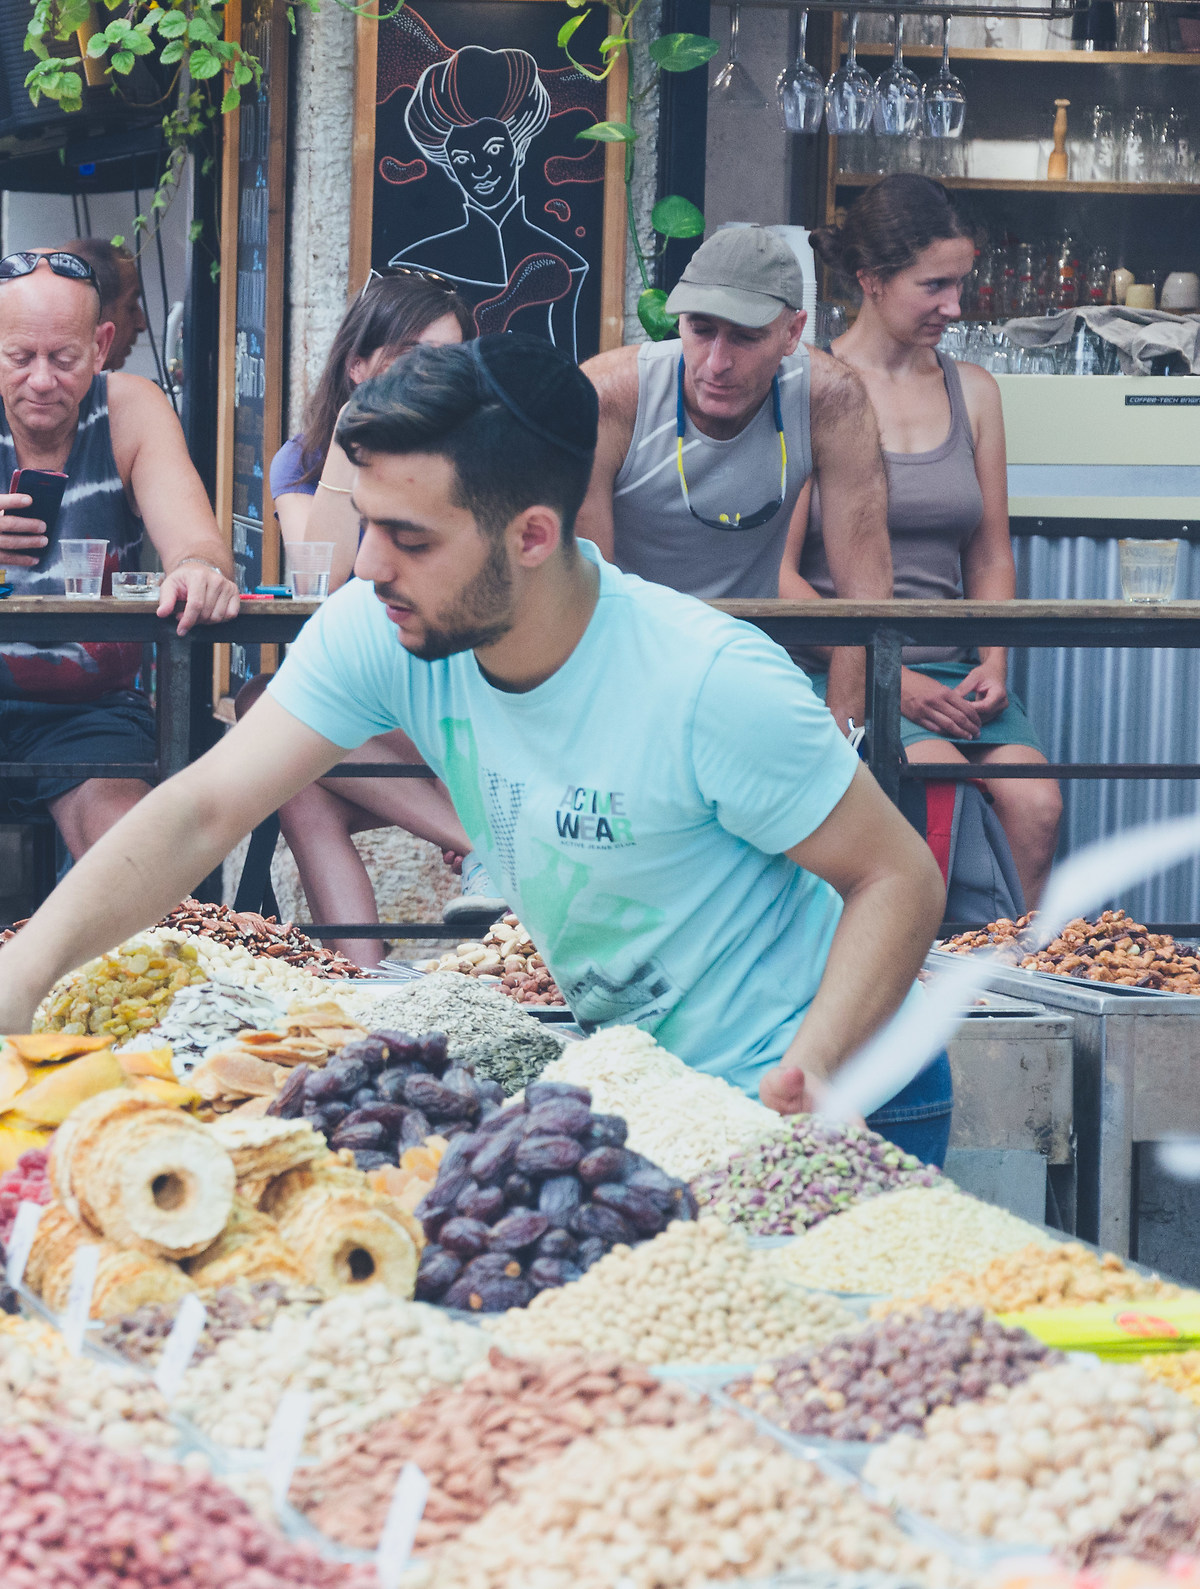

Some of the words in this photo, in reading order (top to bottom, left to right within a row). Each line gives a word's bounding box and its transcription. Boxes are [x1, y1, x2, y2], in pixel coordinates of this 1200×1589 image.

[560, 784, 626, 816] ACTIVE
[556, 810, 634, 843] WEAR
[561, 840, 585, 849] ACTIVE
